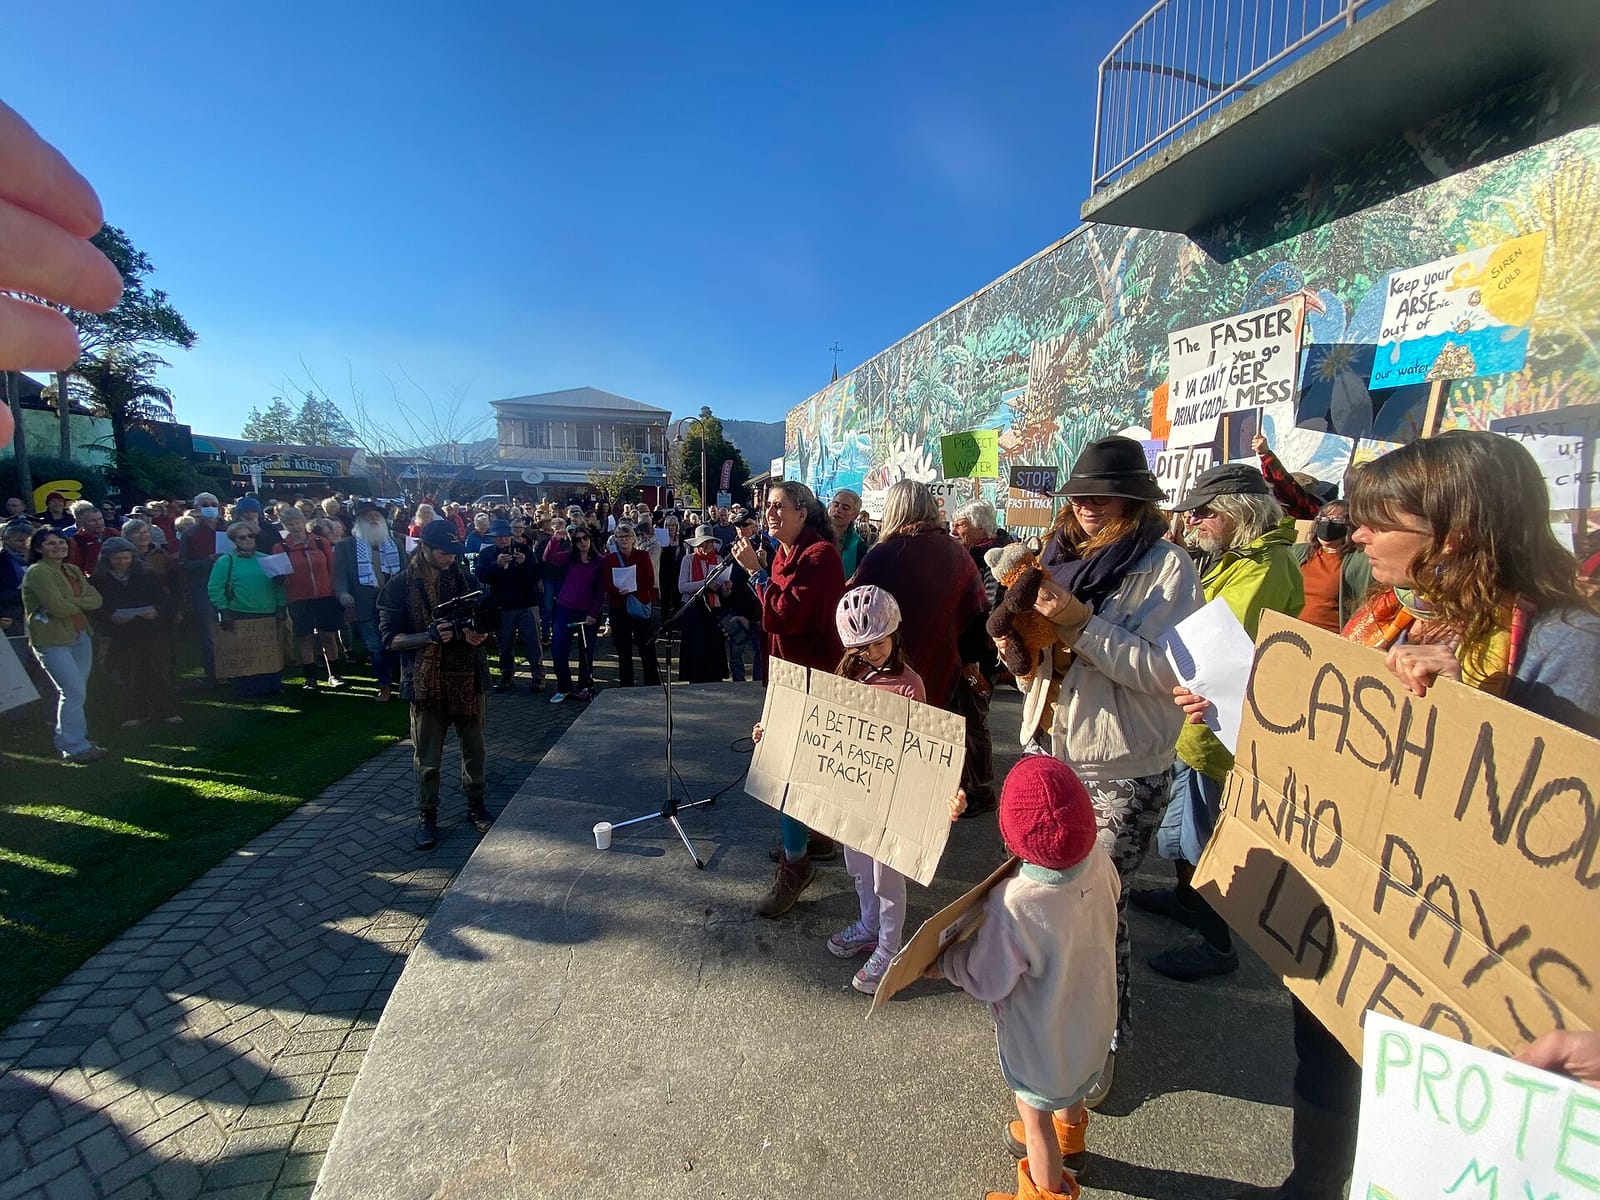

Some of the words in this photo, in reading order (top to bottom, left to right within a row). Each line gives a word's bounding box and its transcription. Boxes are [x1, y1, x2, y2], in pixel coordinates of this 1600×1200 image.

[1490, 247, 1523, 279] SIREN
[1389, 277, 1420, 298] Keep
[1421, 266, 1455, 293] your
[1497, 268, 1522, 291] GOLD
[1173, 337, 1201, 356] The
[1210, 308, 1292, 349] FASTER
[1382, 319, 1408, 339] out
[1416, 313, 1434, 331] of
[1261, 345, 1281, 363] go
[1229, 360, 1267, 386] GER
[1375, 368, 1392, 381] our
[1398, 357, 1429, 377] water
[1185, 378, 1197, 399] YA
[1235, 378, 1292, 409] MESS
[1173, 401, 1201, 427] DRINK
[1199, 395, 1223, 422] GOLD
[294, 457, 334, 474] Kitchen
[952, 460, 993, 473] WATER
[1555, 471, 1600, 486] CRE
[1008, 499, 1028, 509] FAST
[1029, 497, 1053, 510] TRACK
[1020, 488, 1041, 498] THE
[1247, 630, 1437, 799] CASH
[806, 704, 819, 728] A
[825, 709, 893, 745] BETTER
[903, 728, 953, 768] PATH
[802, 729, 831, 750] NOT
[832, 740, 844, 756] A
[847, 743, 895, 775] FASTER
[817, 754, 873, 794] TRACK!
[1250, 739, 1344, 869] WHO
[1373, 833, 1593, 1044] PAYS
